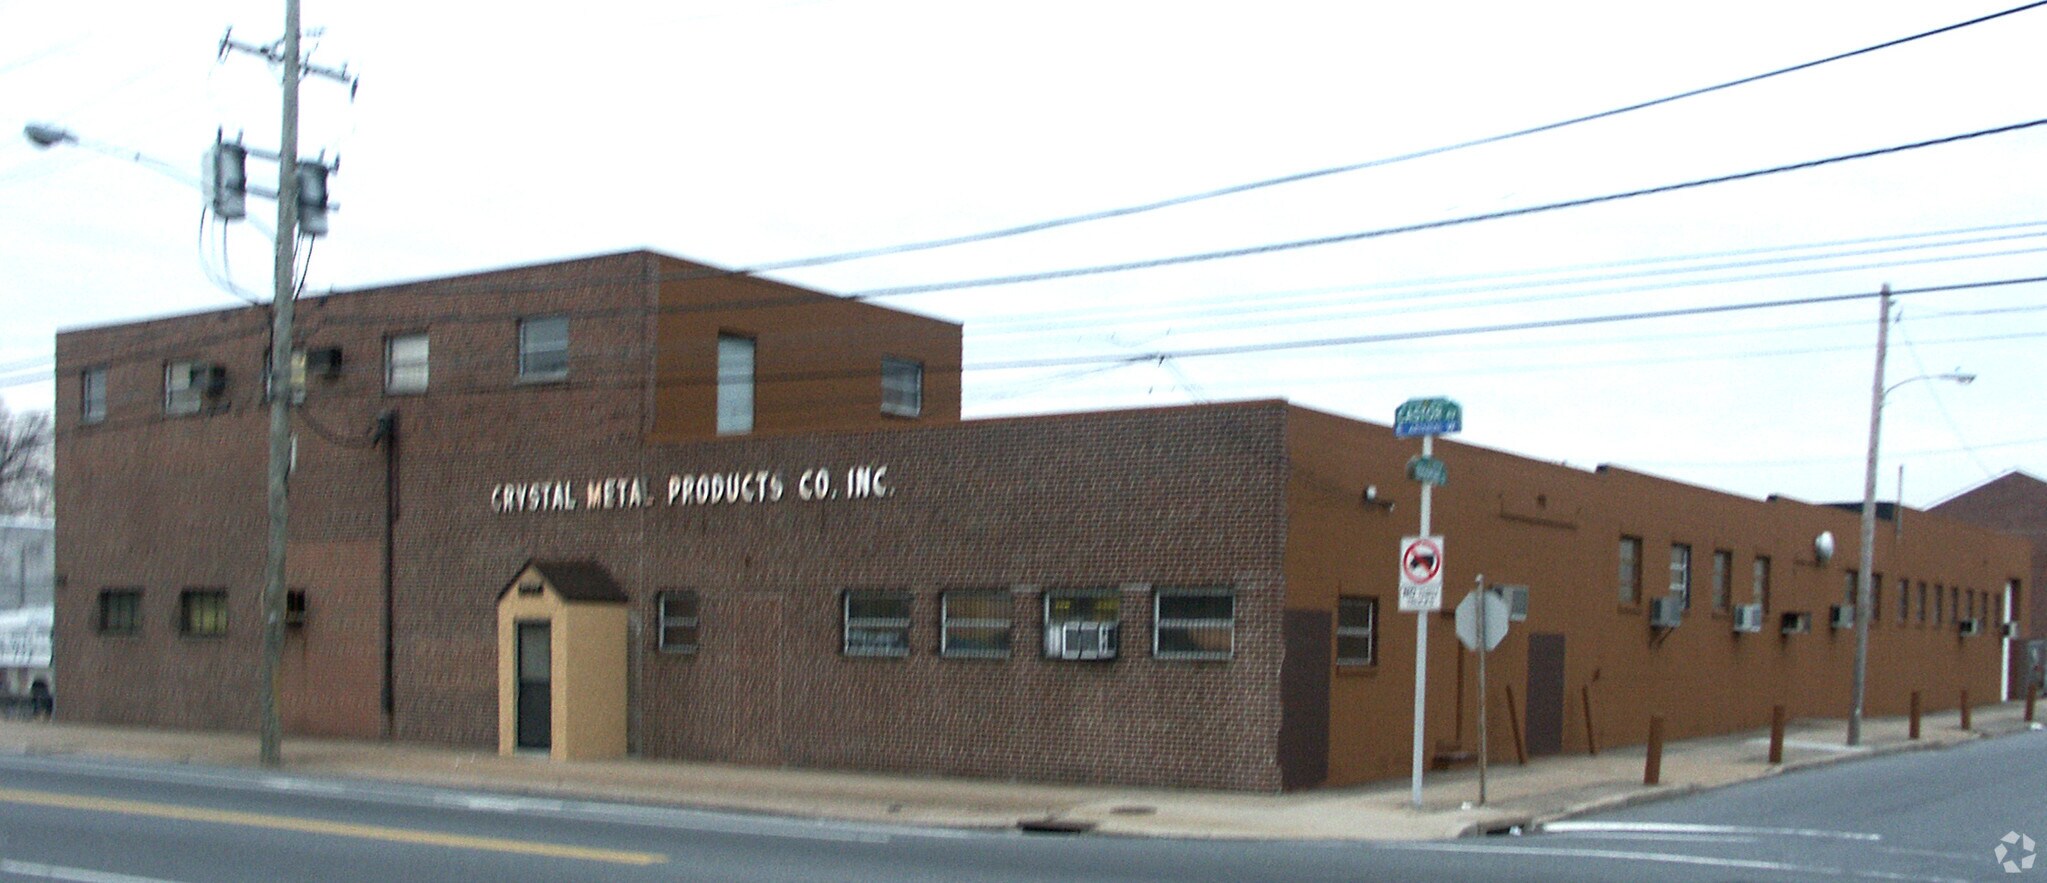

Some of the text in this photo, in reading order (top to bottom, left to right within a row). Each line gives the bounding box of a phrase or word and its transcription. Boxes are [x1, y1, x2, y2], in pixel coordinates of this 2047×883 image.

[491, 464, 895, 513] CRYSTAL METAL PRODUCTS CO. INC.
